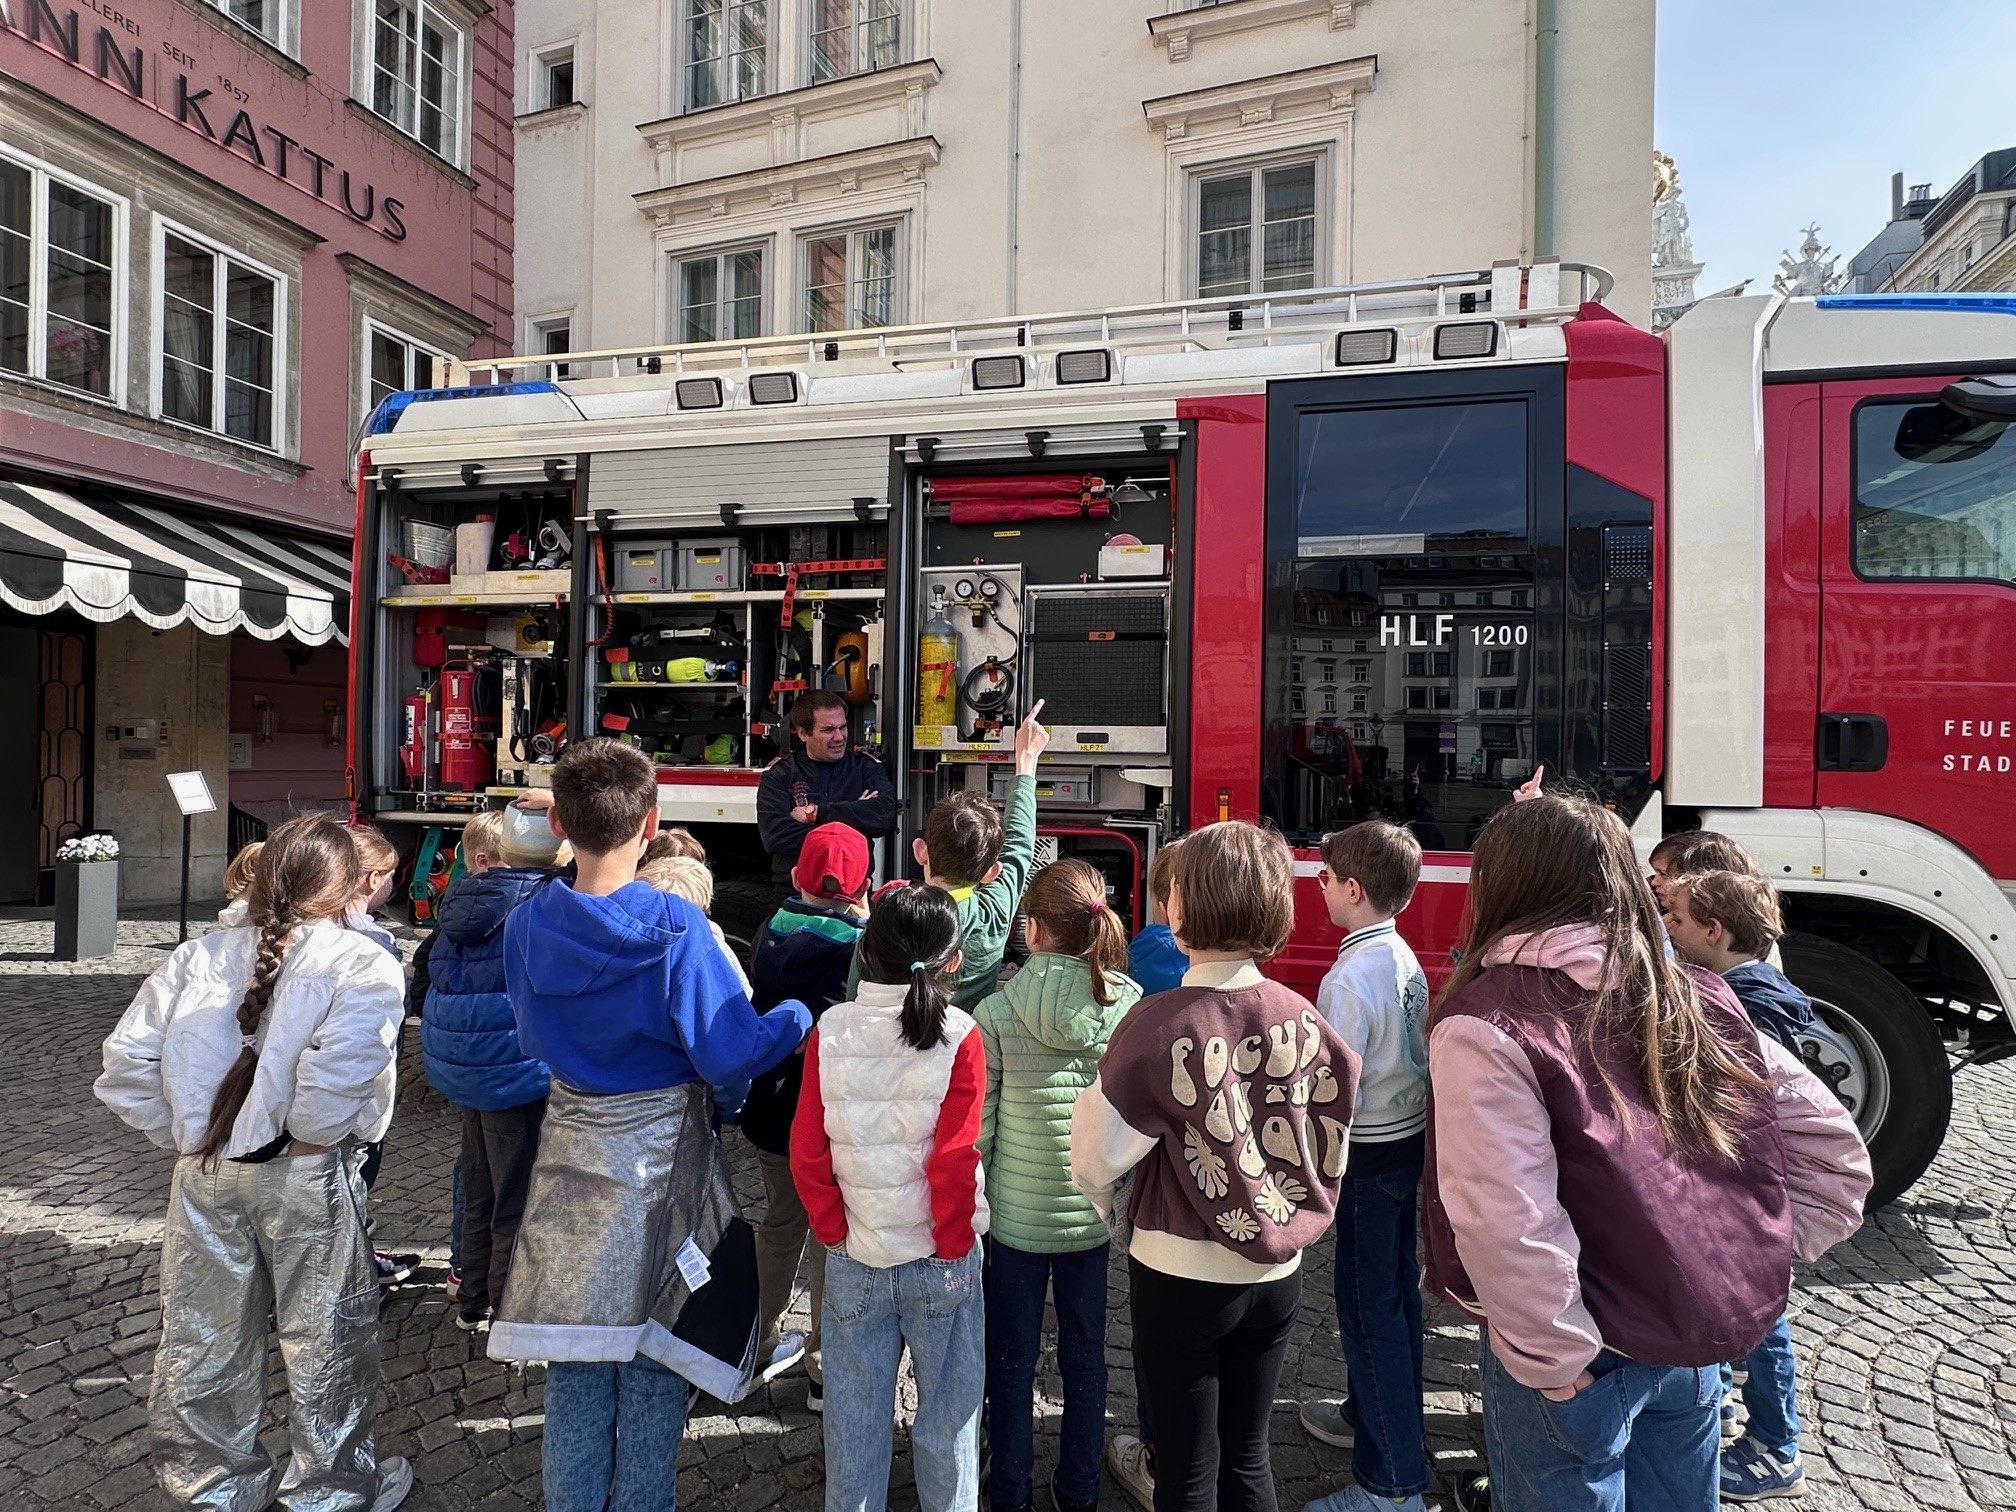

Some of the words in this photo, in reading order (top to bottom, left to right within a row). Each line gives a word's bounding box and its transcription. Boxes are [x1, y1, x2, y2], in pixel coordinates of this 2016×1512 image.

[77, 0, 140, 37] LLEREI
[163, 41, 196, 69] SEIT
[217, 75, 249, 104] 1857
[0, 0, 143, 99] NN
[178, 73, 407, 241] KATTUS
[1380, 614, 1454, 647] HLF
[1470, 625, 1528, 646] 1200
[1944, 719, 2012, 738] FEUE
[1942, 754, 2011, 773] STAD
[1170, 1009, 1322, 1107] FOCUS
